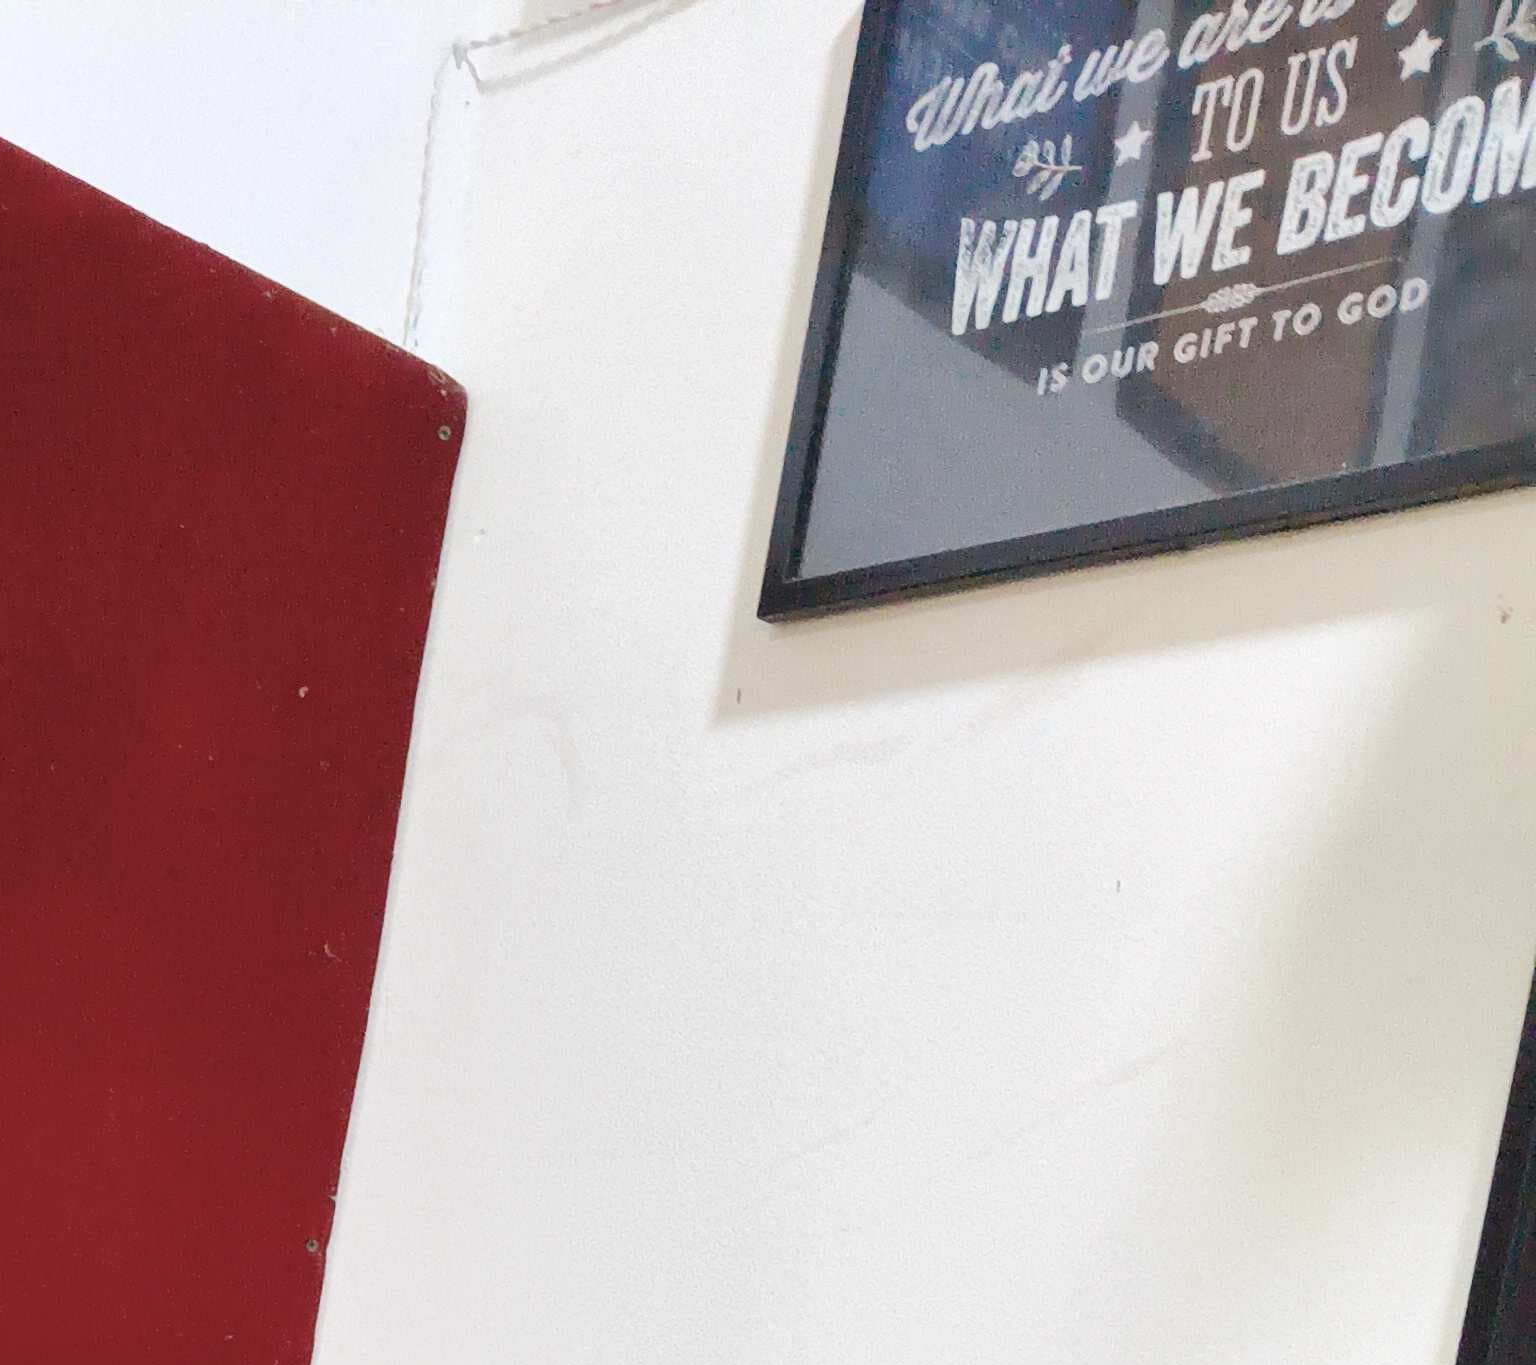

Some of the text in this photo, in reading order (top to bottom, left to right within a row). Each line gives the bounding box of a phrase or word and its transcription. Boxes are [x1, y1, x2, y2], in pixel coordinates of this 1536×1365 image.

[906, 43, 1072, 151] What
[1073, 28, 1170, 101] we
[1178, 0, 1293, 69] are
[1191, 35, 1358, 162] TO US
[951, 76, 1536, 336] WHAT WE BECOM
[1037, 276, 1428, 396] IS OUR GIFT TO GOD
